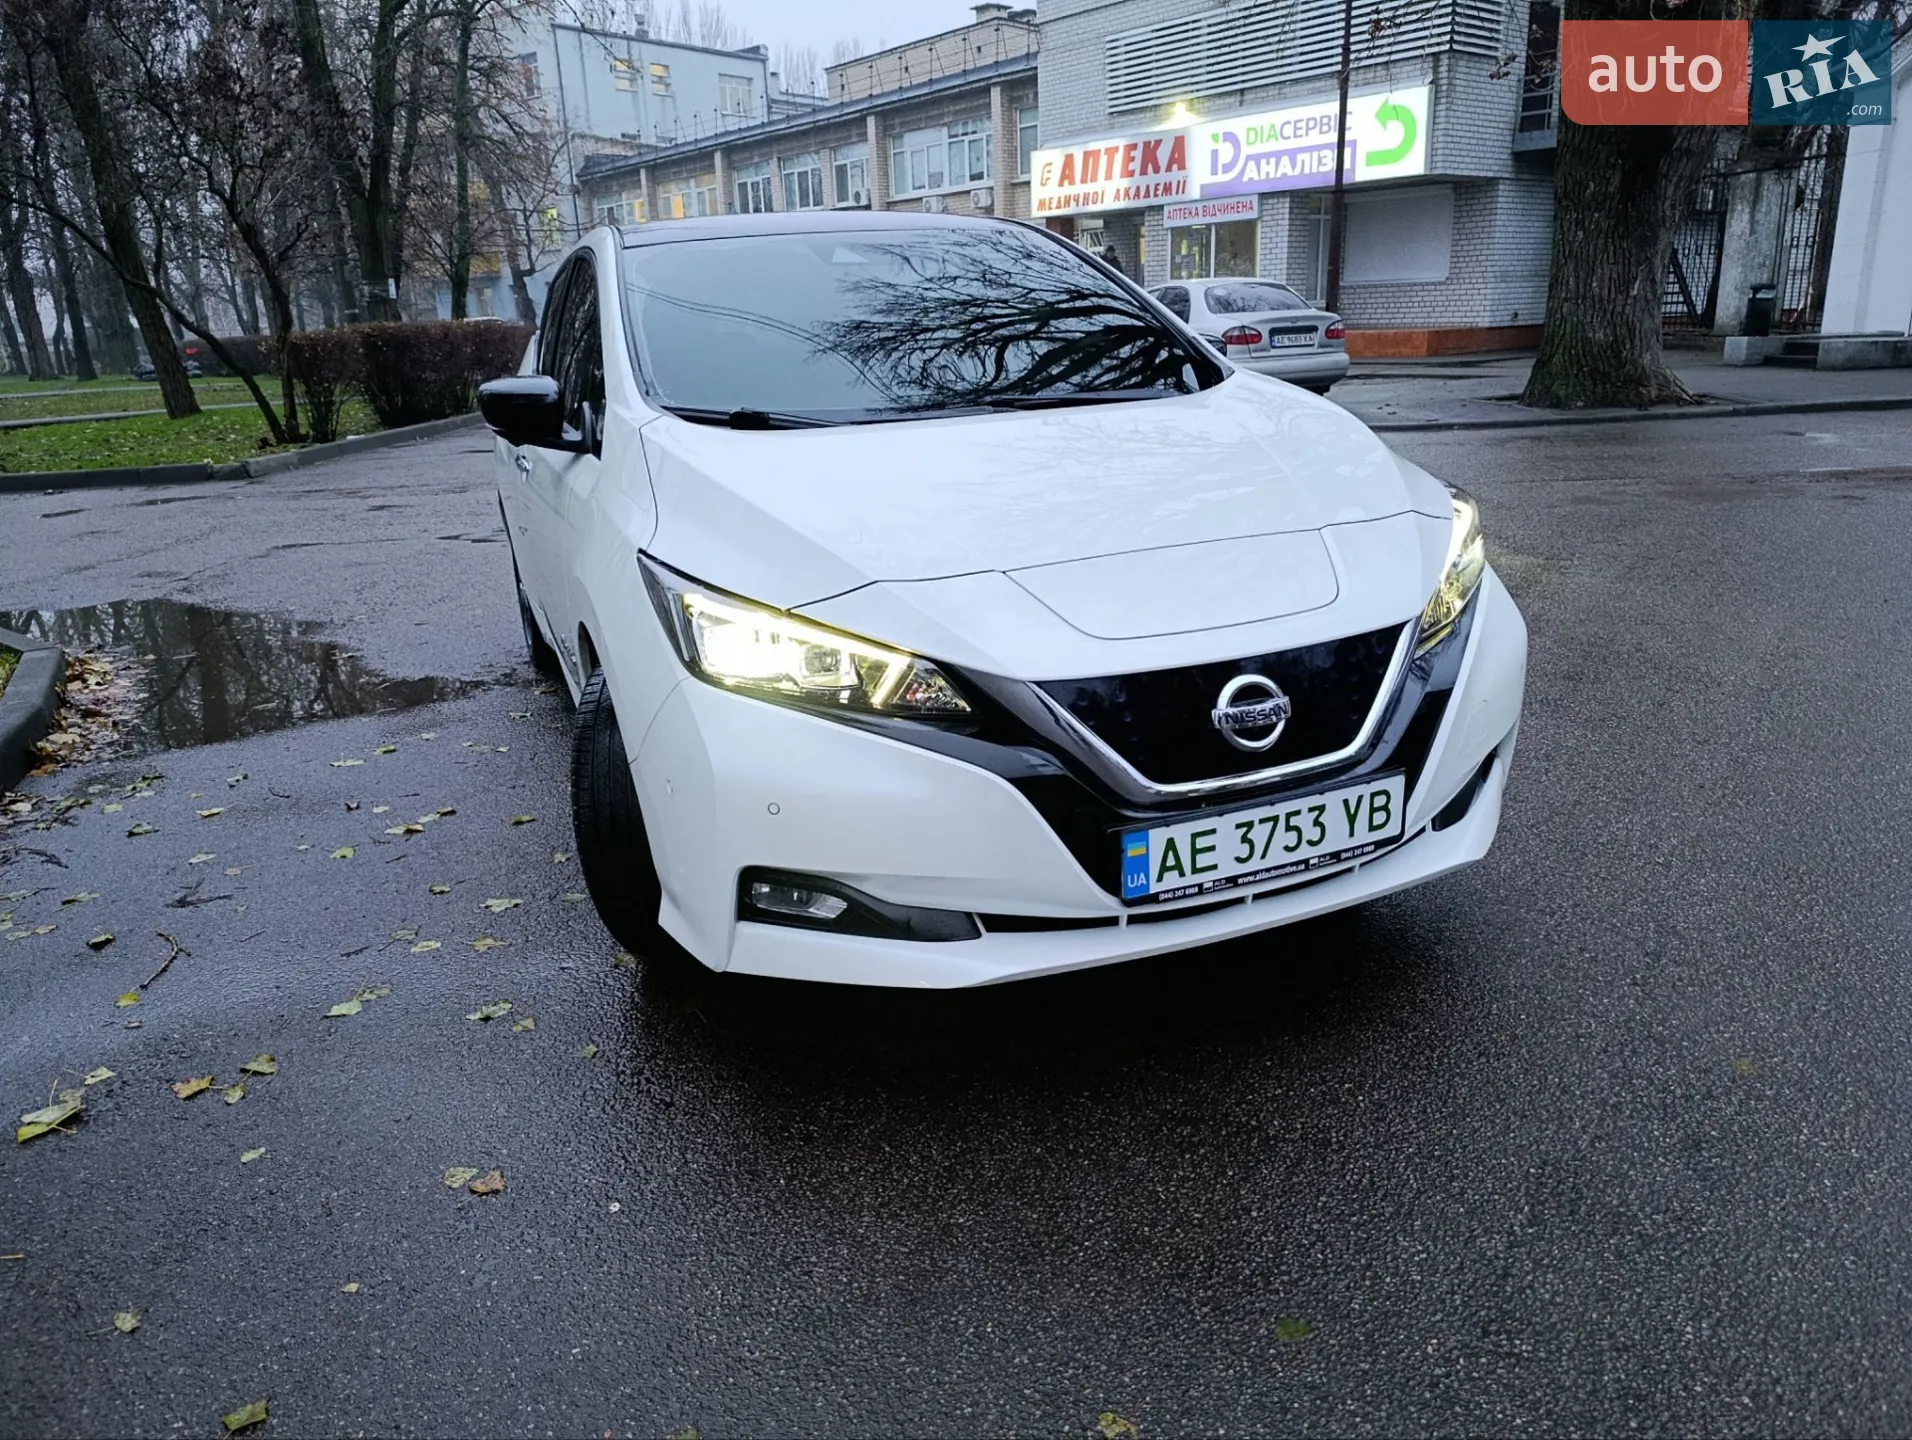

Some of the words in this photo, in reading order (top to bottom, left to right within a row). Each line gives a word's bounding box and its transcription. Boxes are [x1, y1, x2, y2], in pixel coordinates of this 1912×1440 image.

[1057, 134, 1188, 188] АПТЕКА
[1036, 185, 1106, 212] МЕДИЧНОЇ
[1112, 175, 1189, 203] АКАДЕМІЇ
[1166, 204, 1200, 221] АПТЕКА
[1201, 199, 1255, 218] ВІДЧИНЕНА
[1224, 702, 1288, 725] NISSAN
[1155, 827, 1219, 884] AE
[1233, 800, 1328, 865] 3753
[1341, 787, 1393, 840] YB
[1126, 871, 1148, 889] UA
